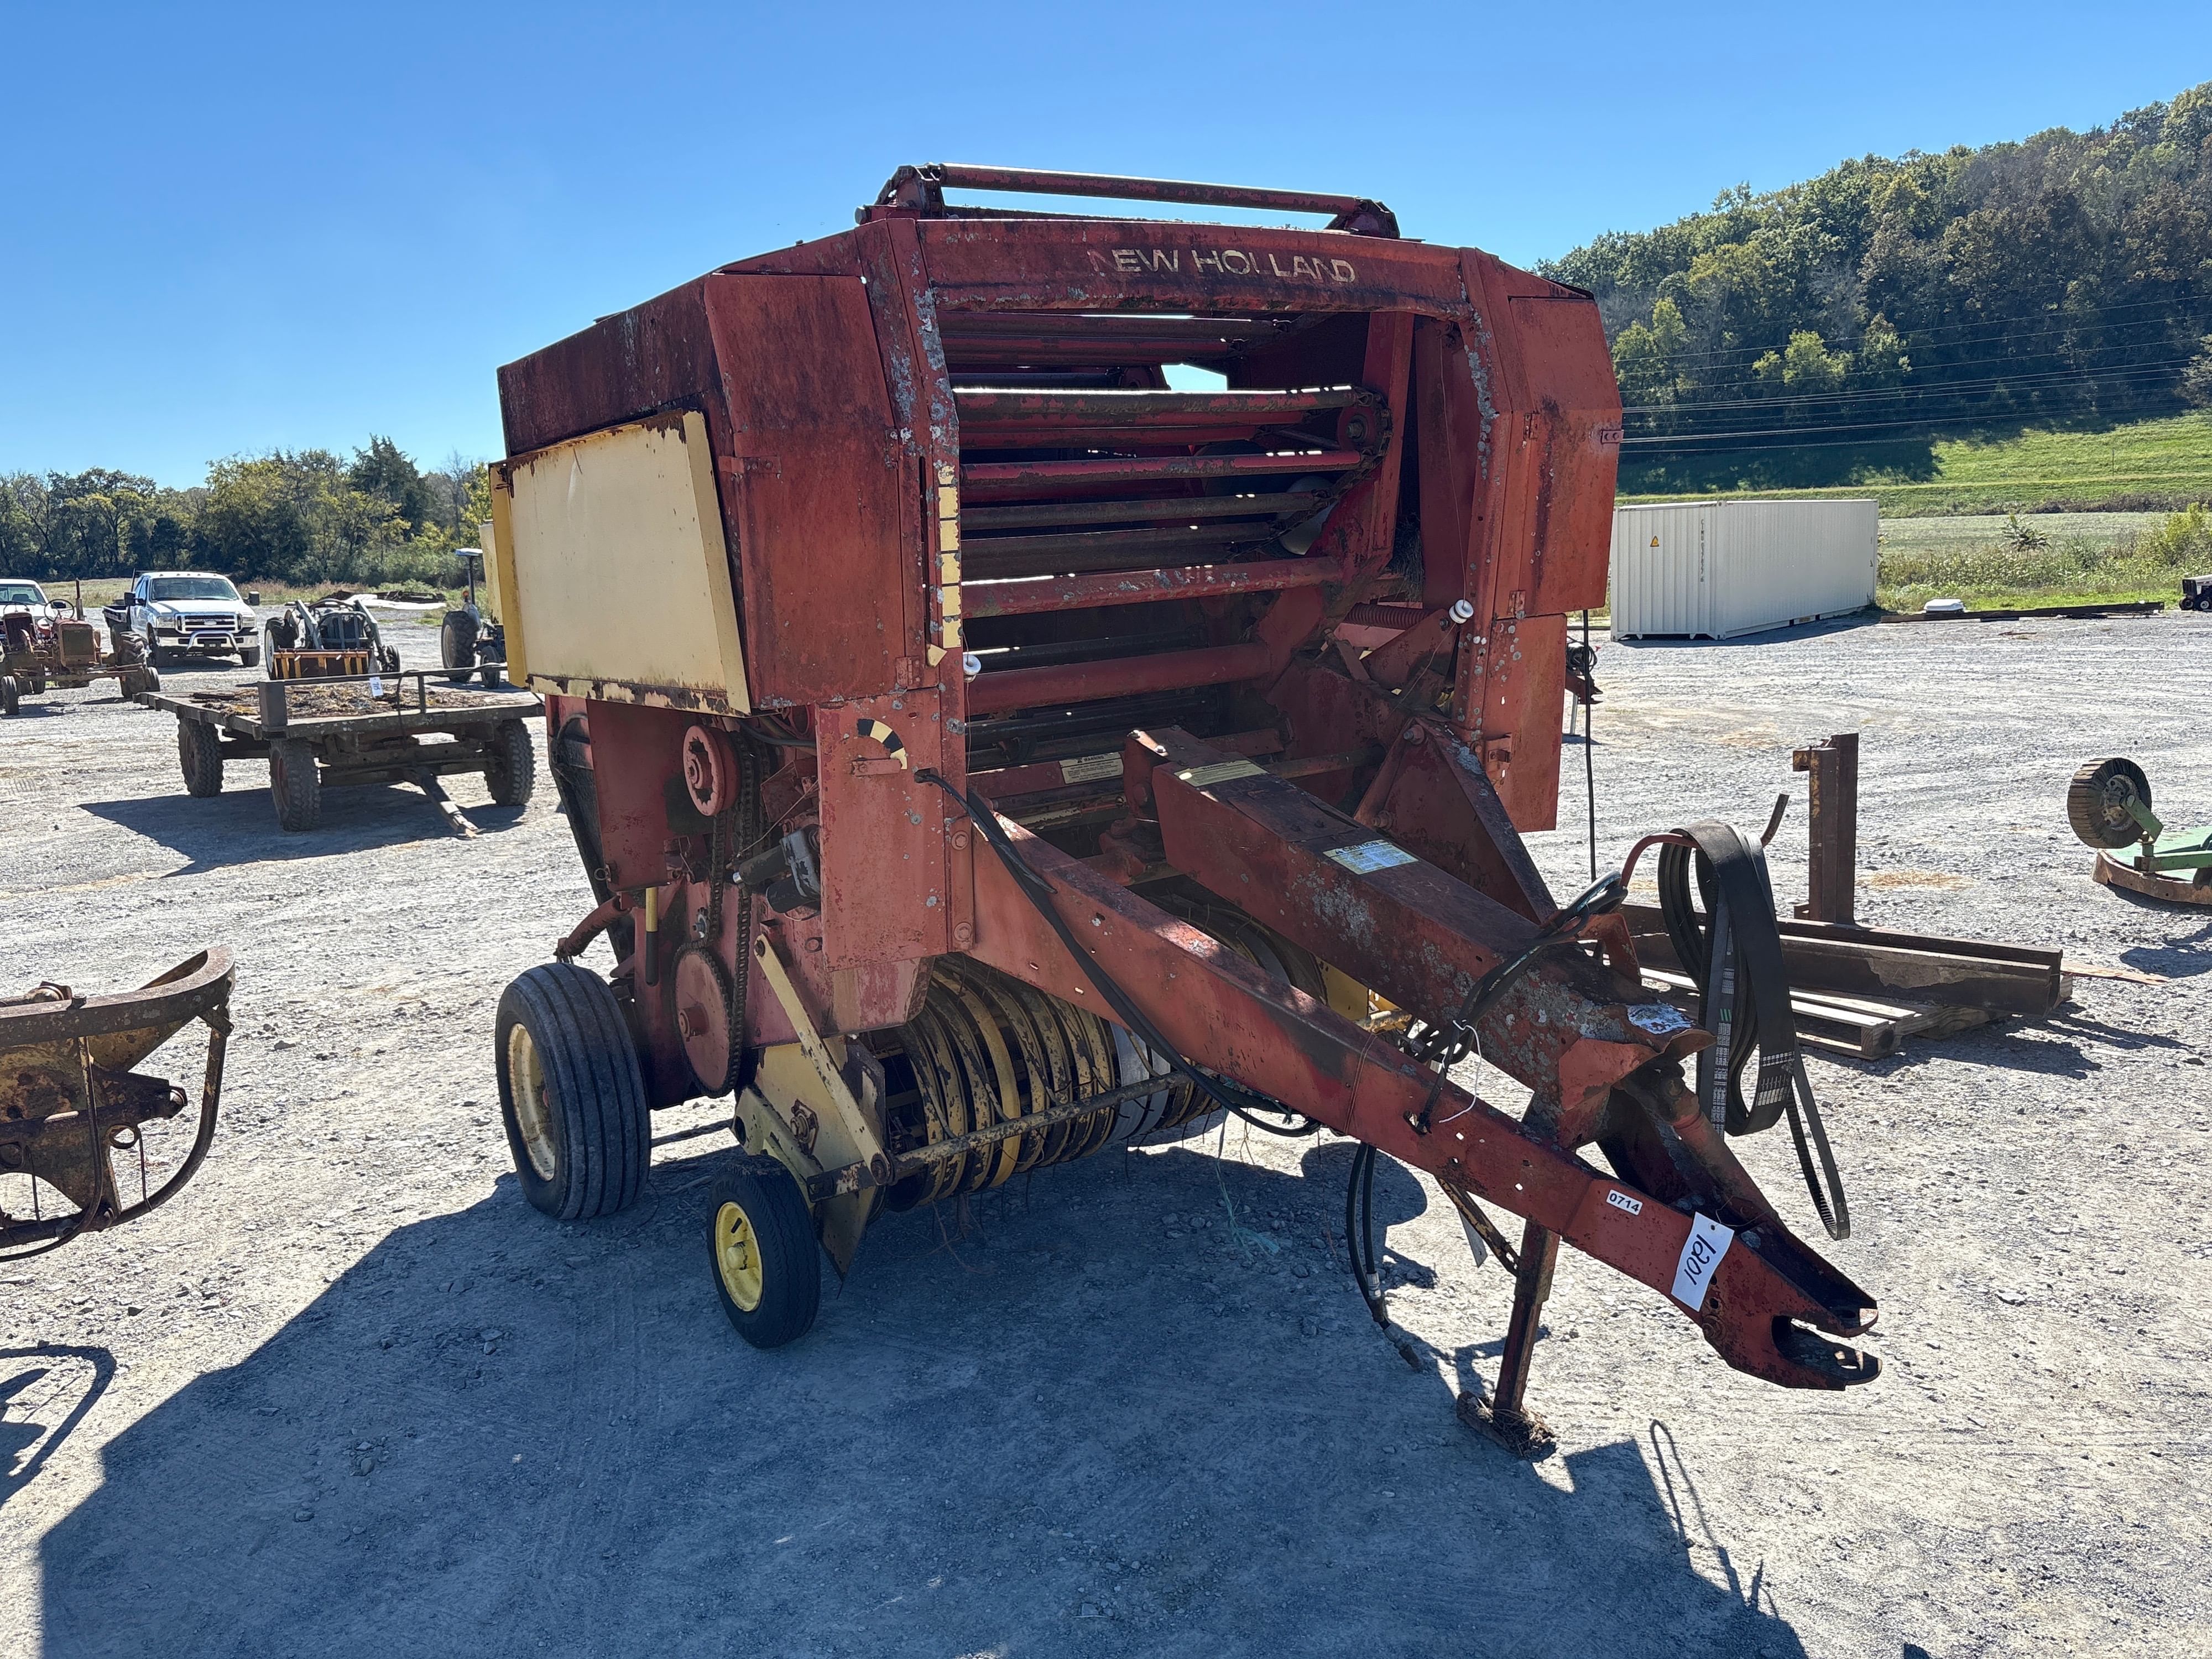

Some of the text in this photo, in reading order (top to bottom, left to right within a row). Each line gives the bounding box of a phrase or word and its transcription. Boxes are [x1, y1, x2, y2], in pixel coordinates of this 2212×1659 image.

[1087, 248, 1356, 283] NEW HOLLAND
[1342, 841, 1380, 852] CAUTION
[1609, 1192, 1640, 1213] 0714
